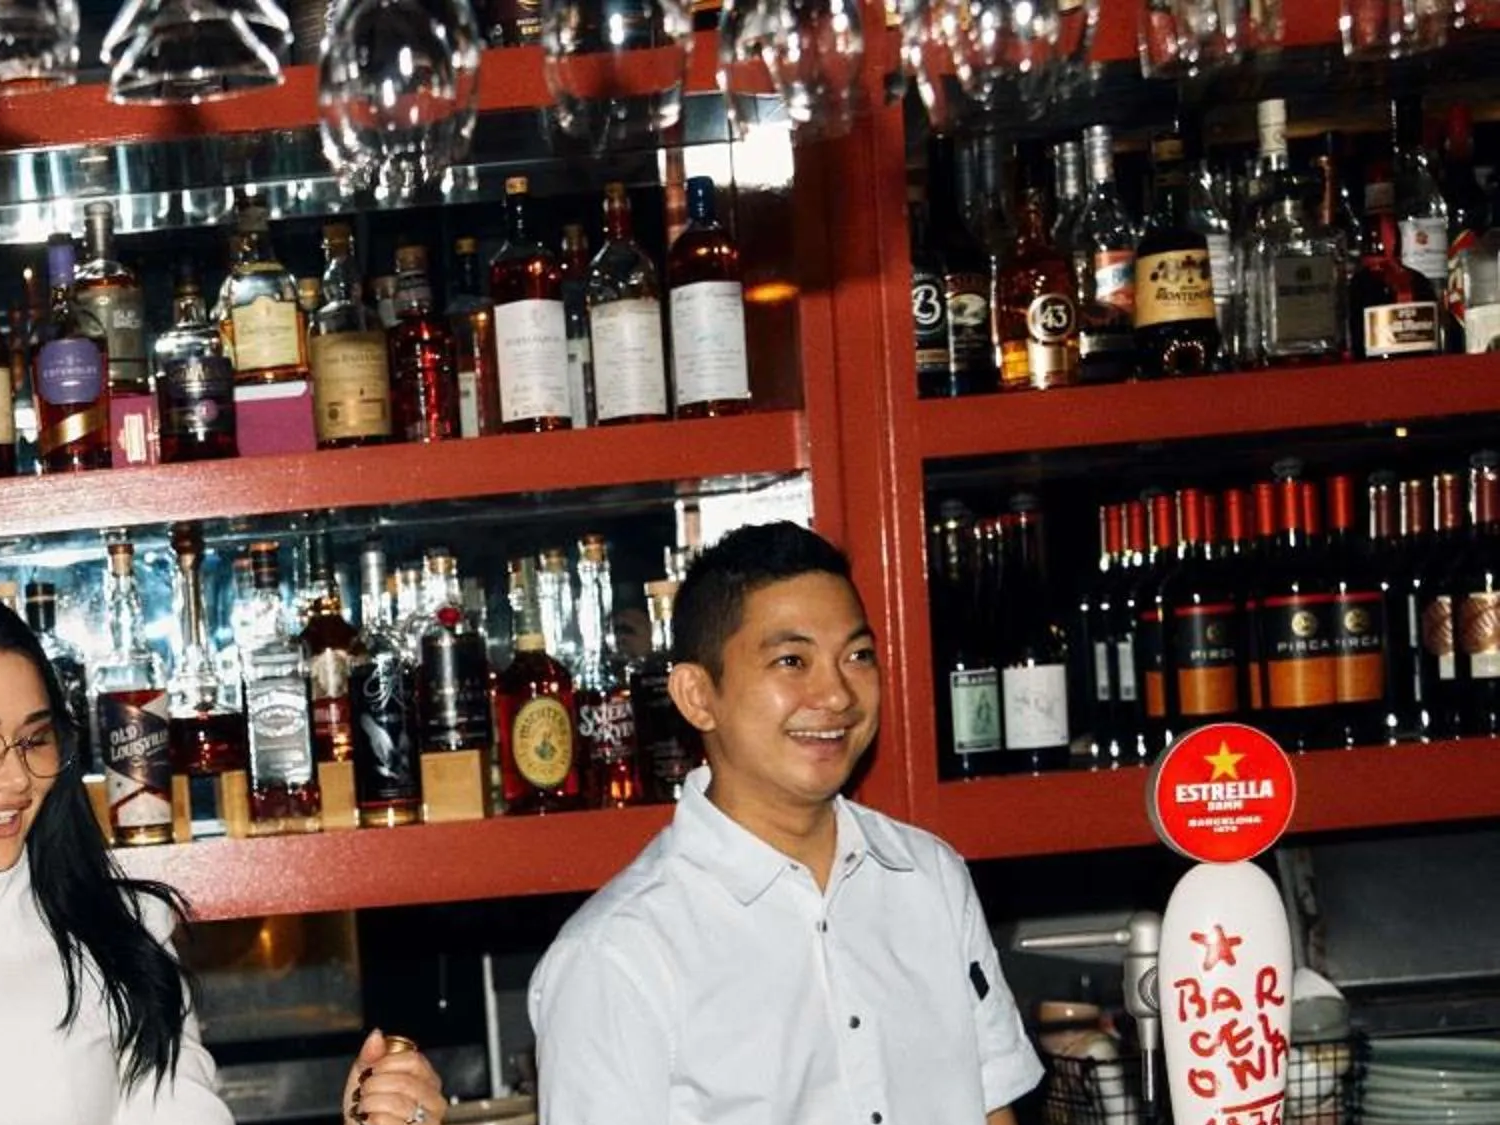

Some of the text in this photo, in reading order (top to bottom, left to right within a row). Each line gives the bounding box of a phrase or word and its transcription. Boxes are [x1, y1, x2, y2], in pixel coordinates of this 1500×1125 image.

[1041, 306, 1067, 328] 43
[110, 724, 138, 745] OLD
[1175, 779, 1274, 802] ESTRELLA
